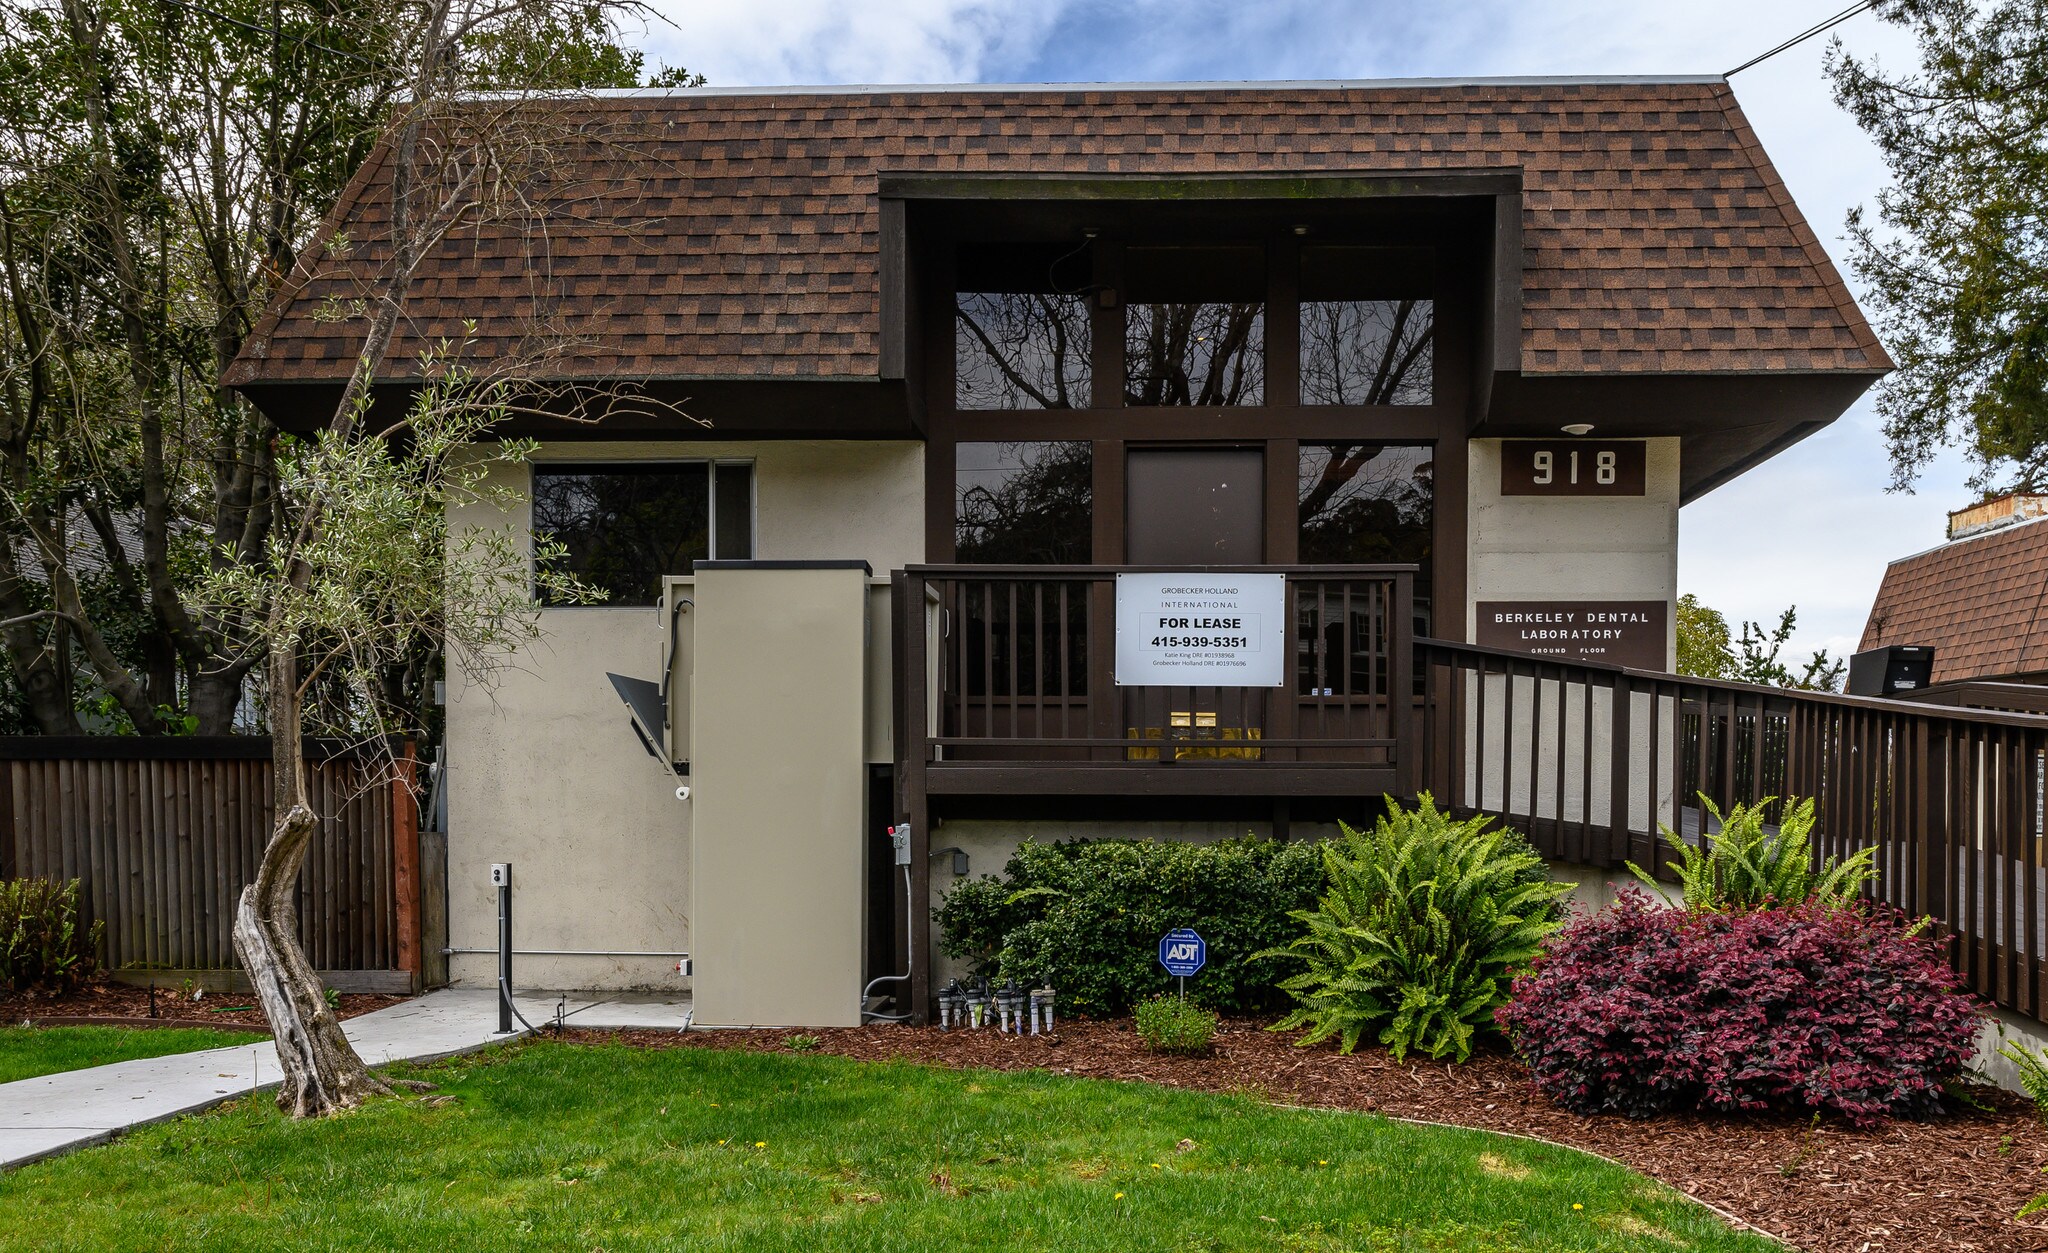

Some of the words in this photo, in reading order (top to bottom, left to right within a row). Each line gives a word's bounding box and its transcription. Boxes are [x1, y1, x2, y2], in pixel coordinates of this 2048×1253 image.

[1533, 451, 1616, 484] 918
[1161, 587, 1203, 595] GROBECKER
[1204, 587, 1239, 595] HOLLAND
[1161, 601, 1238, 609] INTERNATIONAL
[1159, 617, 1189, 629] FOR
[1193, 617, 1241, 629] LEASE
[1495, 613, 1575, 623] BERKELEY
[1587, 613, 1649, 623] DENTAL
[1521, 629, 1622, 640] LABORATORY
[1151, 636, 1247, 648] 415-939-5351
[1179, 652, 1191, 660] King
[1167, 943, 1198, 961] ADT
